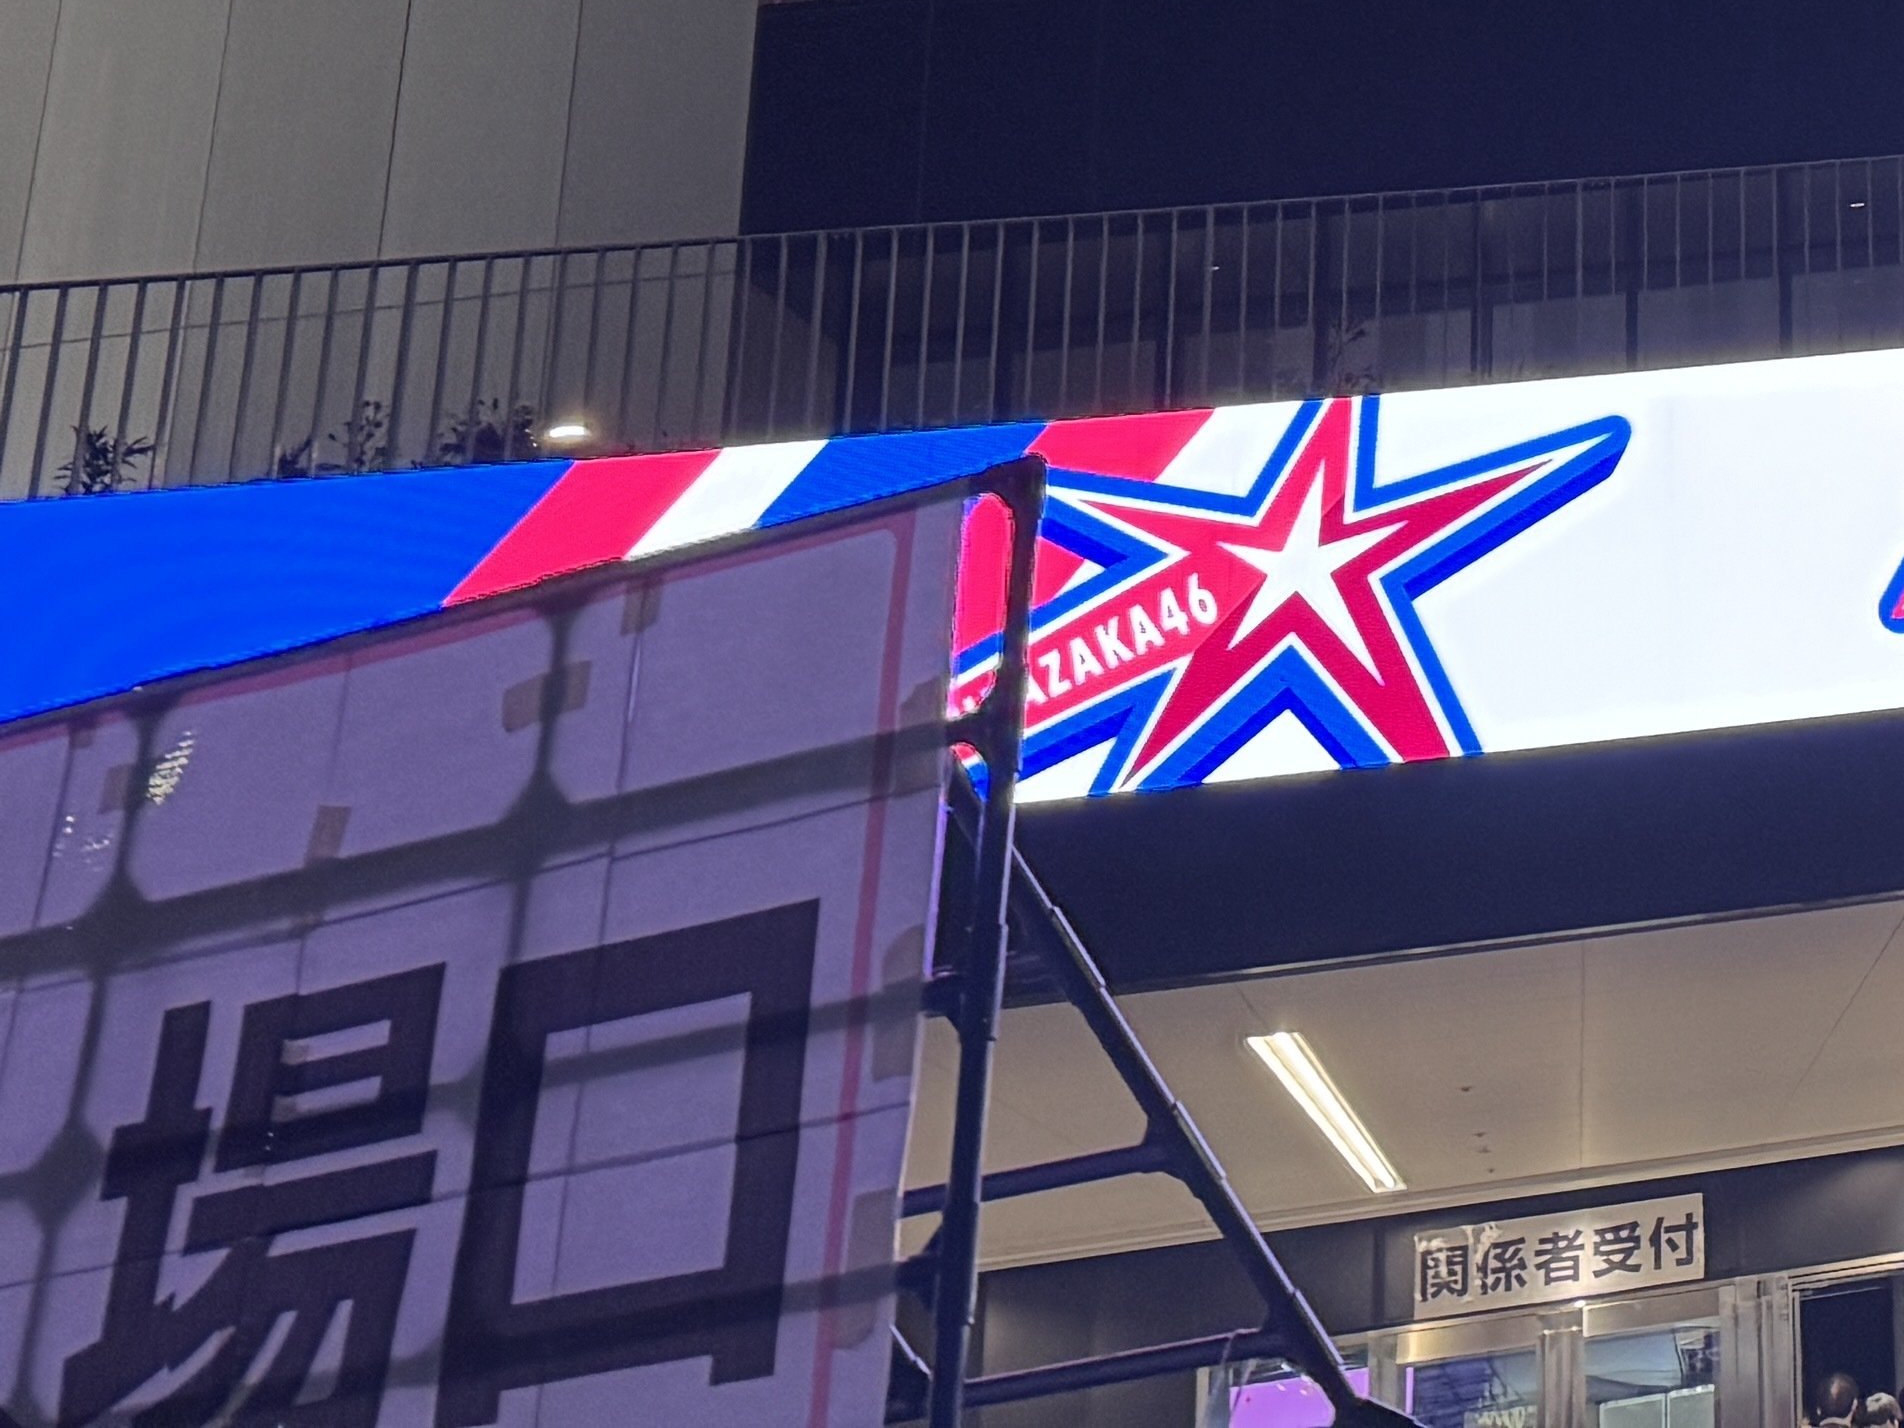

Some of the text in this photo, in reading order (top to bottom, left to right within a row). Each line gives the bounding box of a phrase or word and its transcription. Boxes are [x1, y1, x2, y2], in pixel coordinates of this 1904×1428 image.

[1420, 1212, 1699, 1303] 関係者受付
